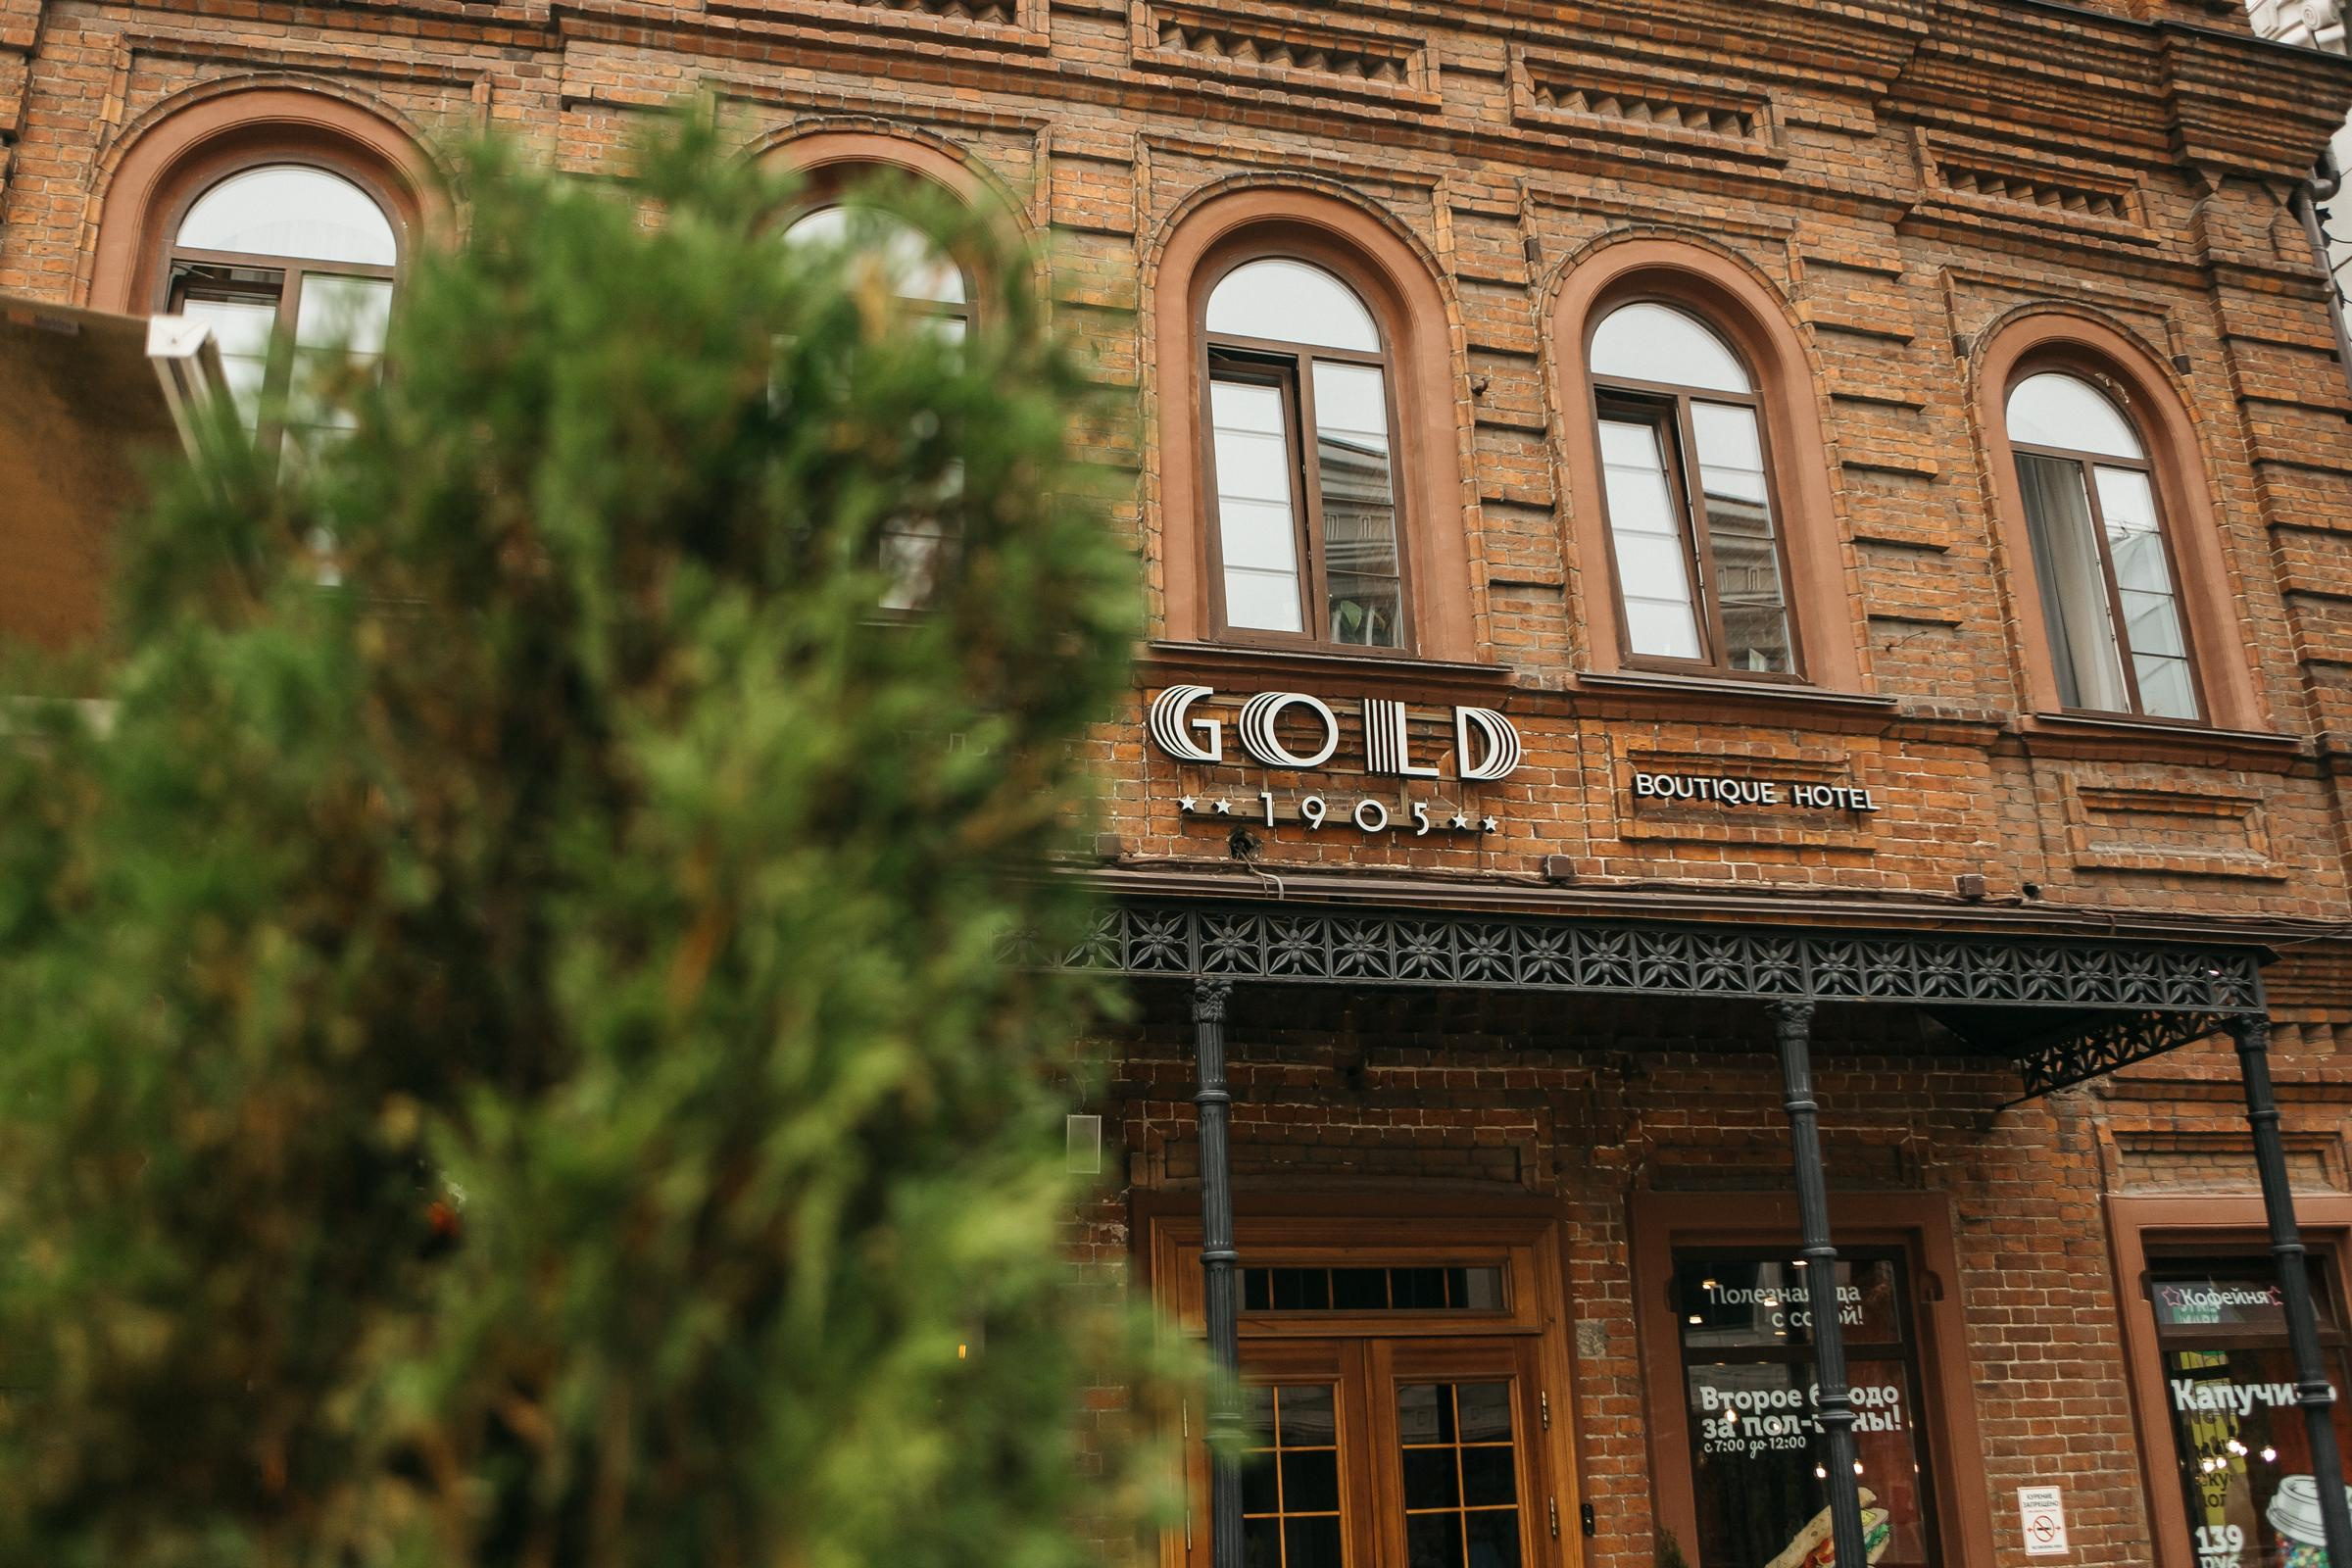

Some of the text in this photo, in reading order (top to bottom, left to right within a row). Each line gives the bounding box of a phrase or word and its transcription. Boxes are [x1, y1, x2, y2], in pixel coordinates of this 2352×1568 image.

[1150, 684, 1522, 781] GOLD
[1635, 773, 1882, 810] BOUTIQUE HOTEL
[1259, 791, 1430, 836] 1905
[2179, 1287, 2270, 1310] Кофейня
[1771, 1312, 1784, 1327] с
[1699, 1383, 1899, 1415] Второе бюдо
[2171, 1378, 2337, 1416] Капучи
[1701, 1417, 1736, 1440] за
[1703, 1442, 1713, 1453] с
[1715, 1439, 1745, 1451] 7:00
[1769, 1436, 1806, 1450] 12:00
[2195, 1524, 2243, 1554] 139
